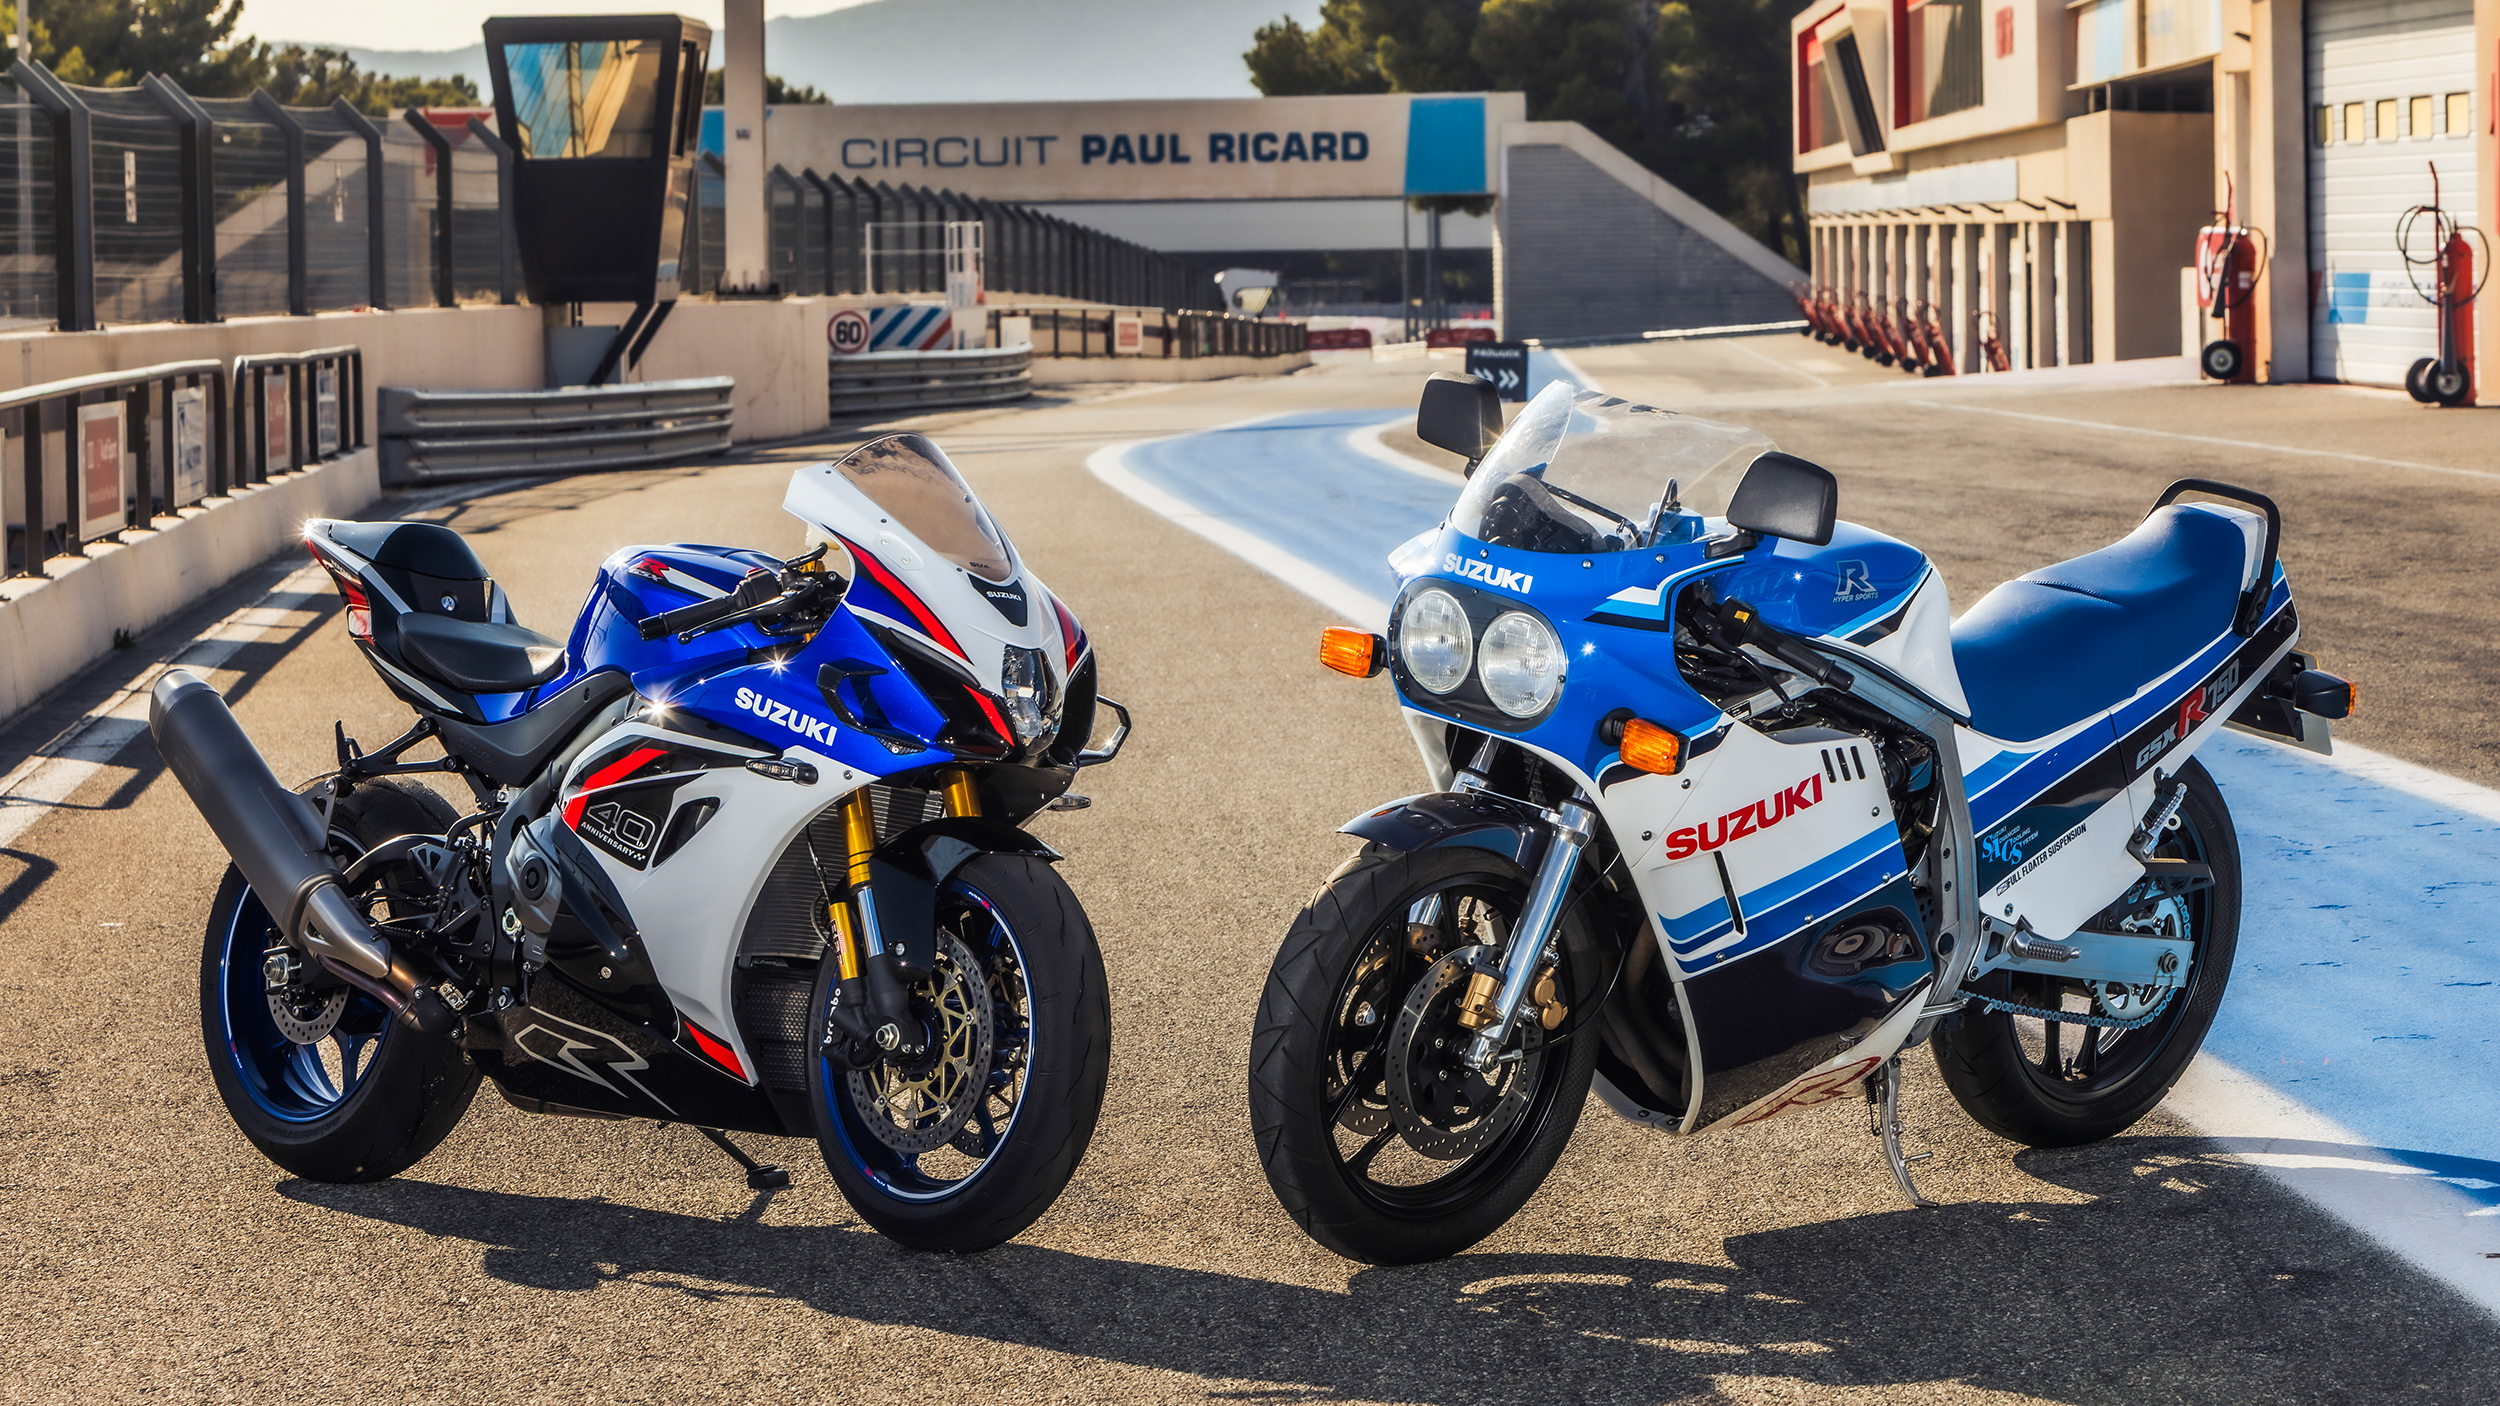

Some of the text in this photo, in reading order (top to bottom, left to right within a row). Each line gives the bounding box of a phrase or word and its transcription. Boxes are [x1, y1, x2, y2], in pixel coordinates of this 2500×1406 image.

[841, 131, 1370, 169] CIRCUIT PAUL RICARD
[835, 319, 862, 344] 60
[1443, 552, 1534, 594] SUZUKI
[1835, 558, 1877, 596] R
[986, 591, 1022, 602] SUZUKI
[1832, 591, 1879, 604] HYPER SPORTS
[734, 687, 838, 747] SUZUKI
[1665, 772, 1823, 861] SUZUKI
[581, 821, 636, 857] ANNIVERSARY
[2007, 822, 2087, 888] FULL FLOATER SUSPENSION
